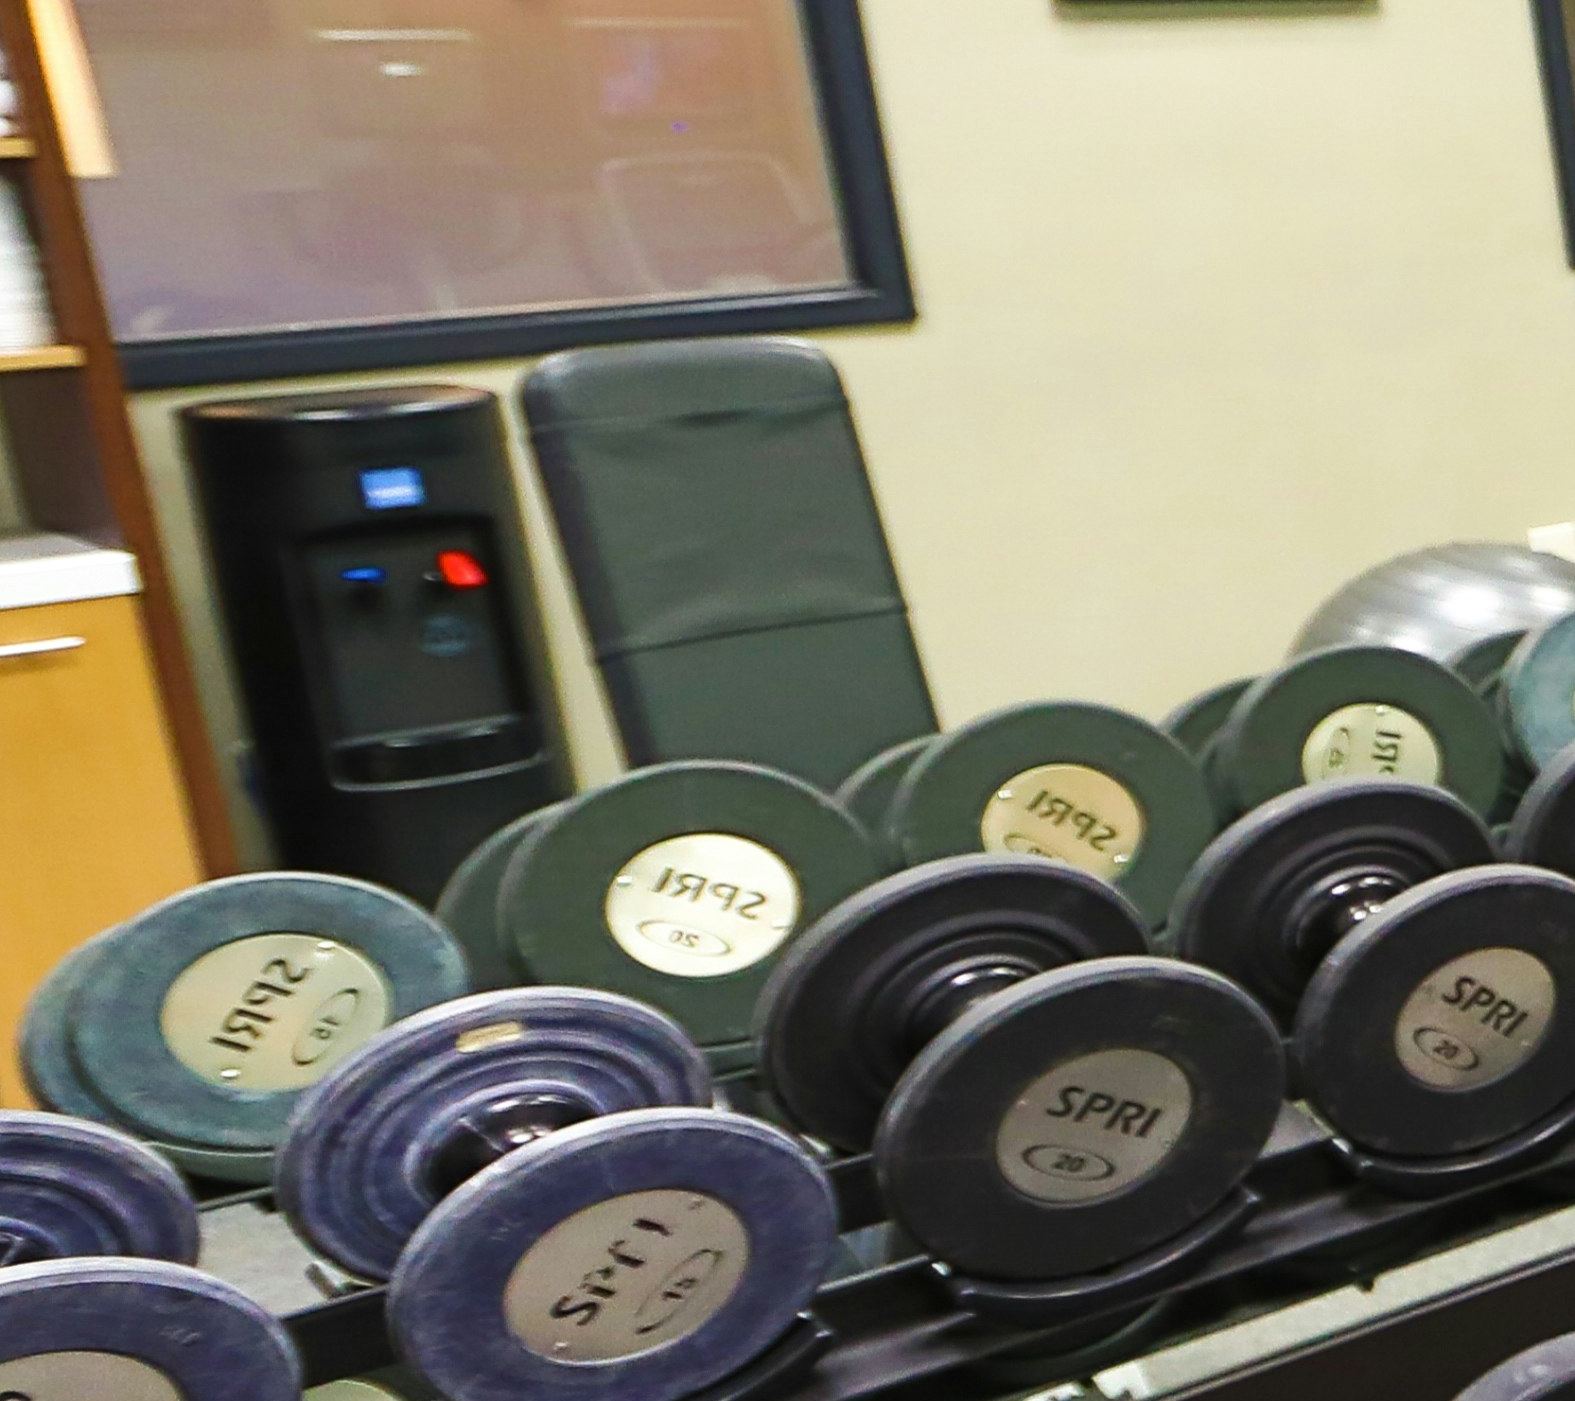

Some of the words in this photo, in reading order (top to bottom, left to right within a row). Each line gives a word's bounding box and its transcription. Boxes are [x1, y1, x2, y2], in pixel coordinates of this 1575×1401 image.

[1442, 976, 1528, 1039] SPRI
[1046, 1086, 1163, 1138] SPRI
[1052, 1154, 1086, 1173] 20
